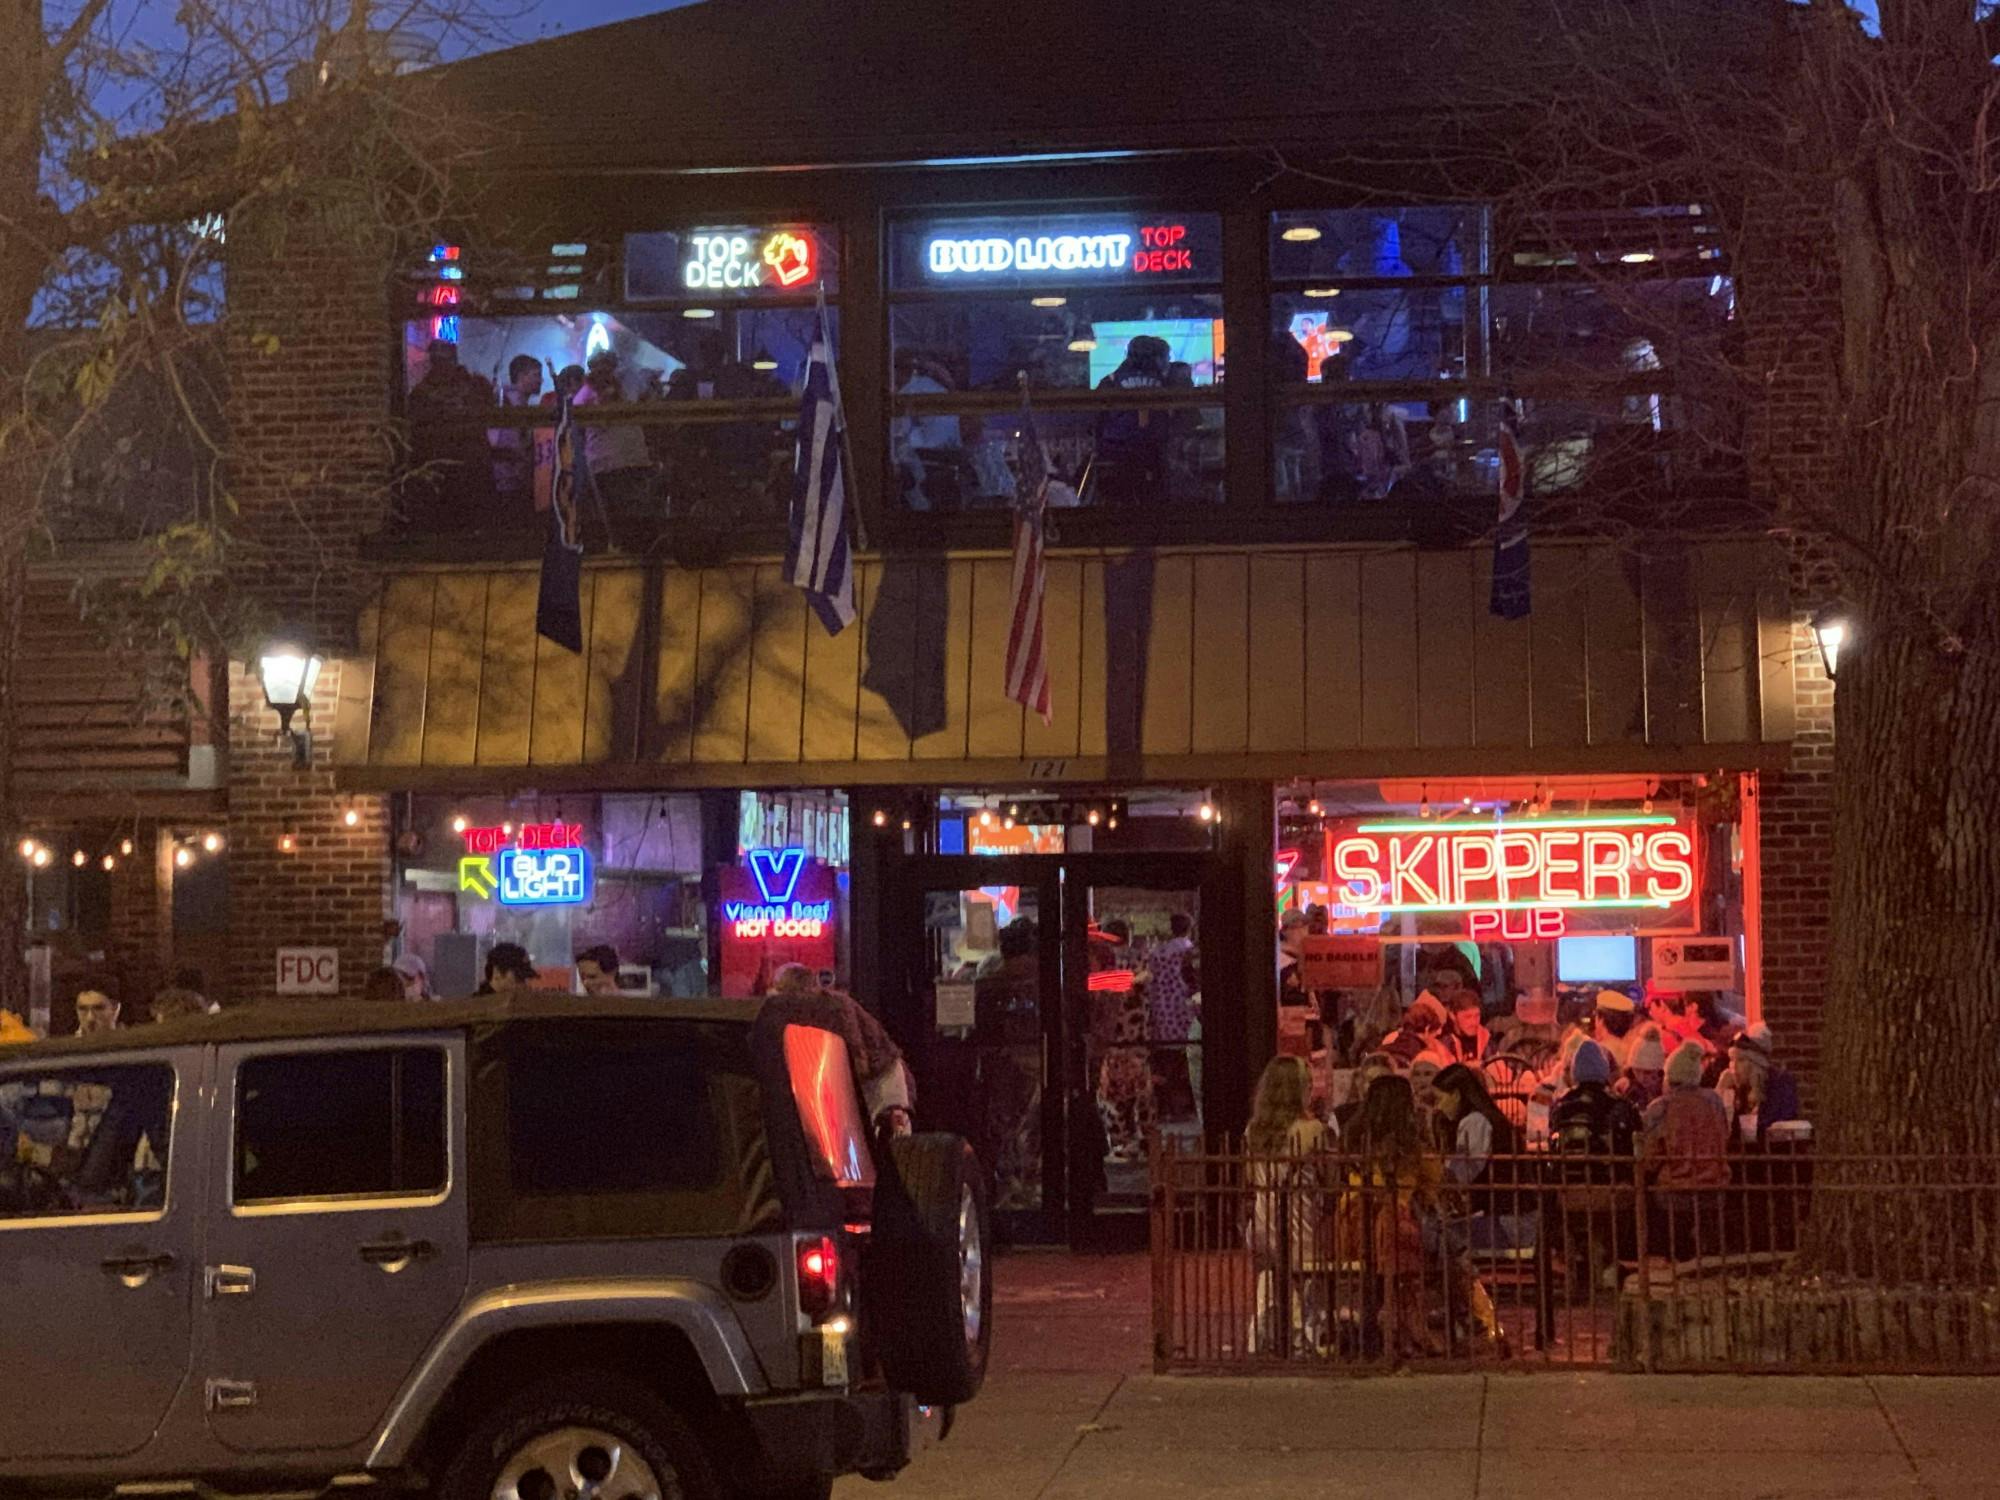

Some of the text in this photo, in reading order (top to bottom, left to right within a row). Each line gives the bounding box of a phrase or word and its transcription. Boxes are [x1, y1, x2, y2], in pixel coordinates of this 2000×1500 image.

[693, 236, 748, 262] TOP
[1141, 226, 1185, 247] TOP
[930, 234, 1131, 272] BUD LIGHT
[1133, 249, 1191, 272] DECK
[686, 261, 760, 287] DECK
[1030, 760, 1066, 777] 121
[465, 823, 582, 853] TOP DECK
[513, 854, 571, 878] BUD
[1334, 832, 1692, 905] SKIPPER'S
[505, 874, 579, 898] LIGHT
[726, 903, 785, 921] Vienna
[1470, 910, 1565, 939] PUB
[736, 919, 821, 937] HOT DOGS
[281, 956, 334, 983] FDC
